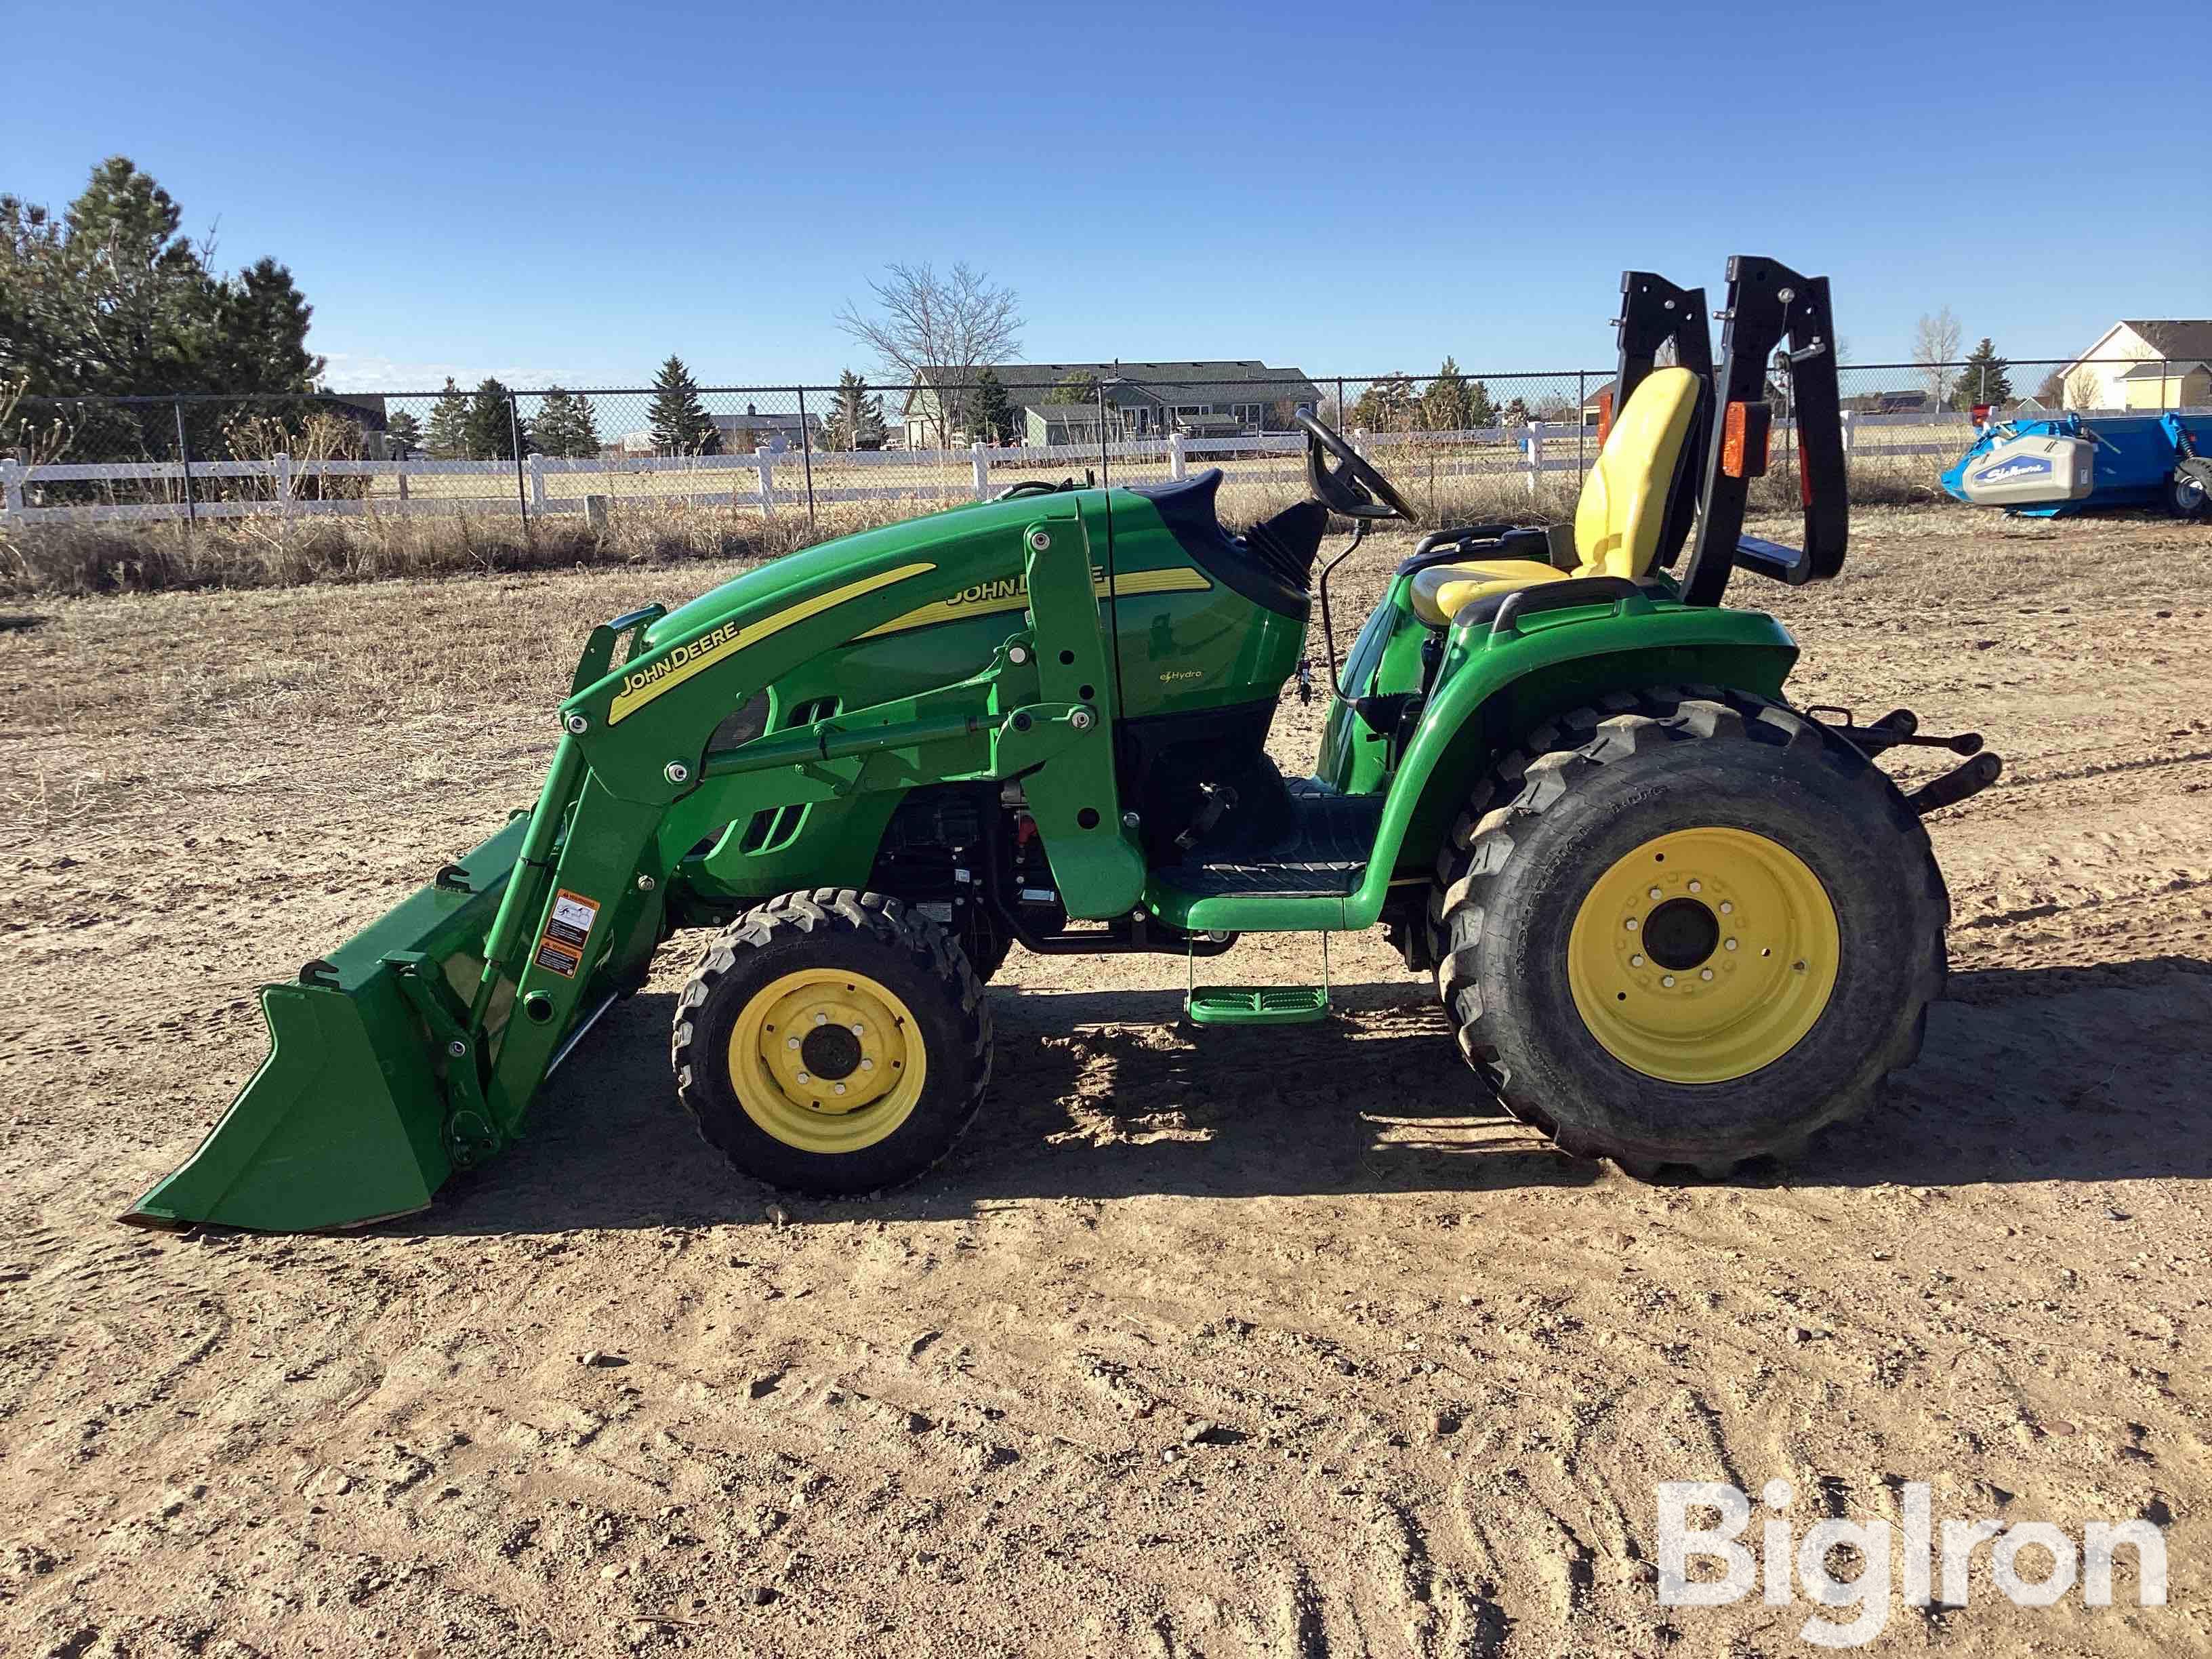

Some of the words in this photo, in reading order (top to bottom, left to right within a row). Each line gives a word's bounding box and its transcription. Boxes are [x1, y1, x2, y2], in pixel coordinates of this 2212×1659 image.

[947, 579, 1015, 605] JOHN
[619, 657, 672, 697] JOHN
[670, 621, 740, 668] DEERE
